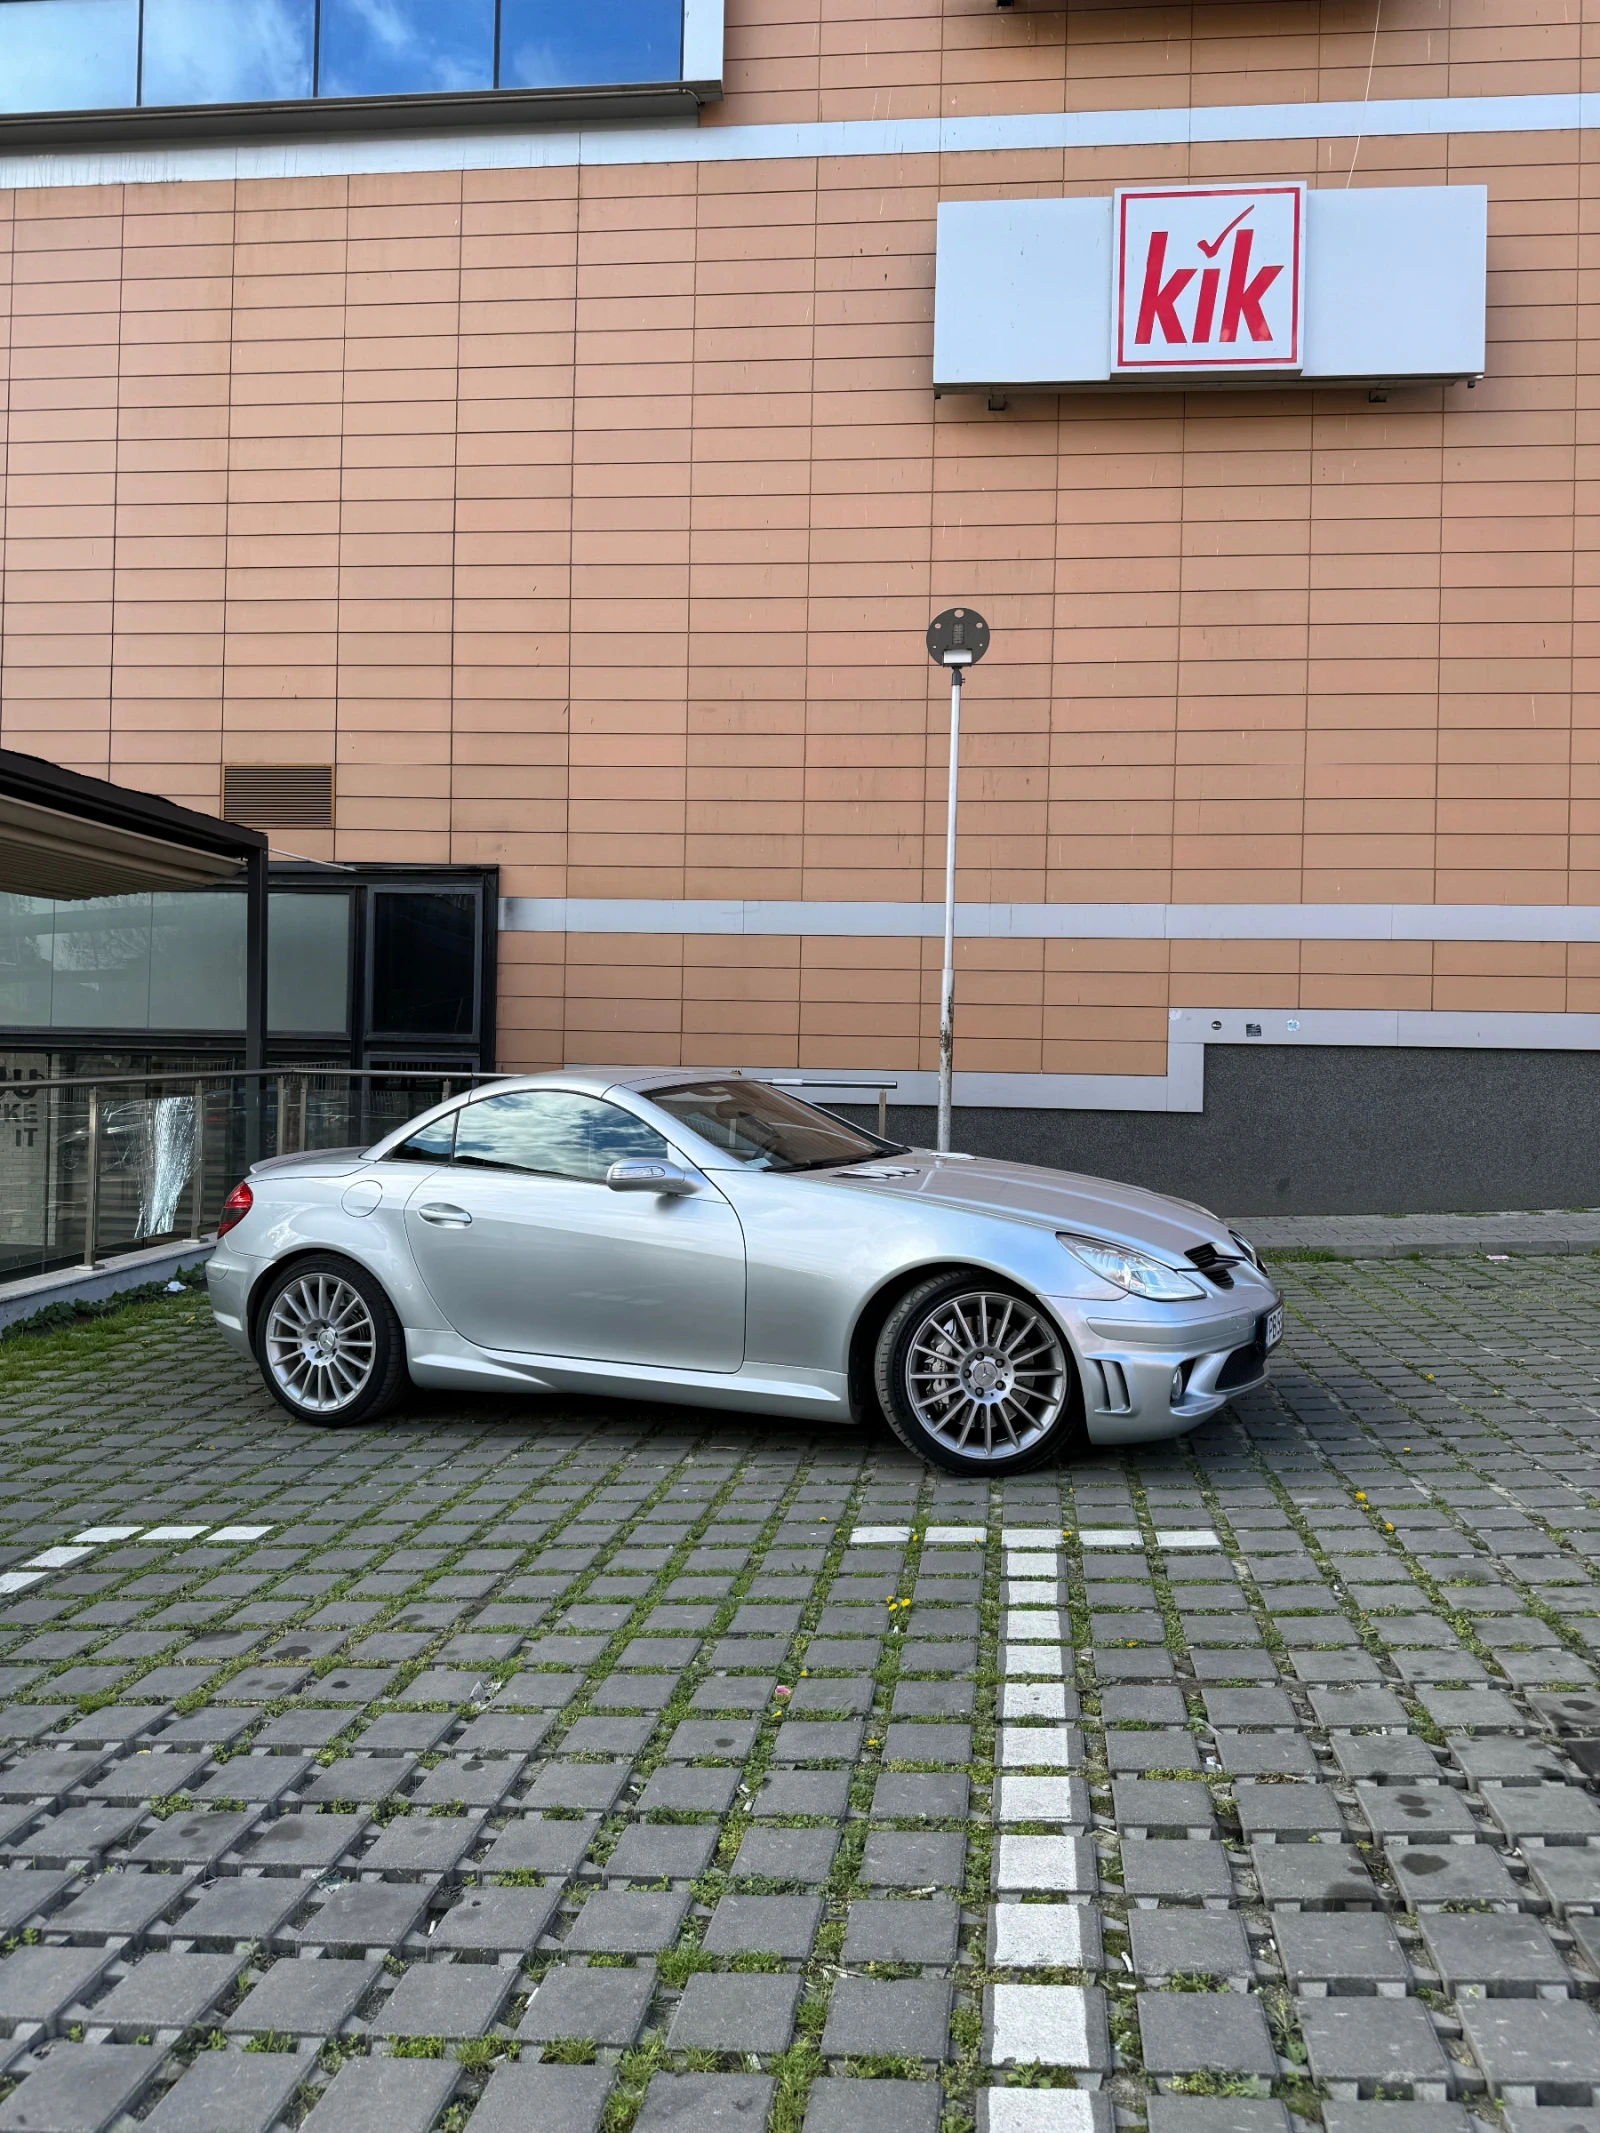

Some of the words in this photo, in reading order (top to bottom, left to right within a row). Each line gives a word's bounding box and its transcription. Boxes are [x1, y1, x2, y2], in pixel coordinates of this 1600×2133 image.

[1134, 204, 1285, 345] kik
[0, 1103, 38, 1123] KE
[15, 1127, 39, 1147] IT
